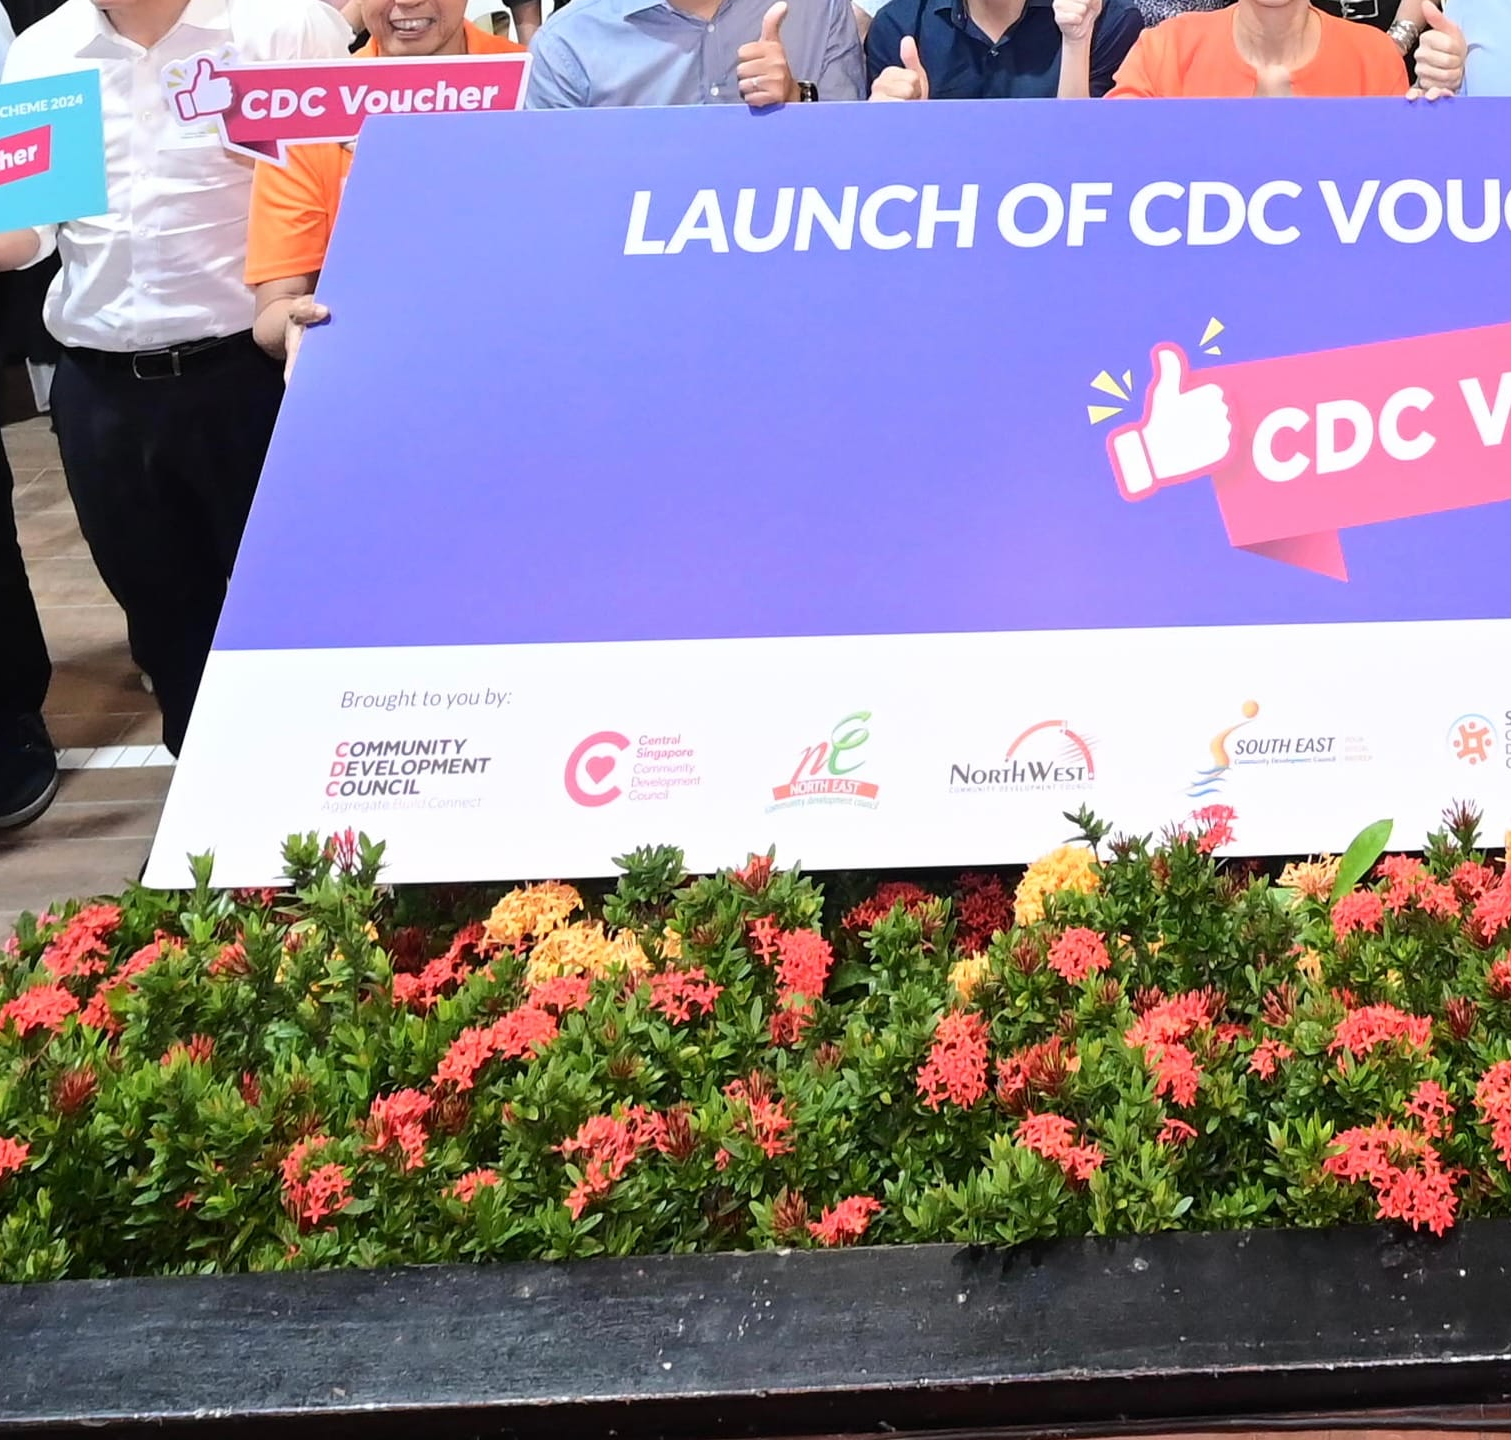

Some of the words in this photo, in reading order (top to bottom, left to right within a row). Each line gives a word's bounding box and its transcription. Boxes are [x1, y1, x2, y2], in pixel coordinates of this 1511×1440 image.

[50, 92, 83, 111] 2024
[241, 88, 327, 120] CDC
[339, 80, 499, 115] Voucher
[621, 183, 981, 258] LAUNCH
[995, 185, 1113, 249] OF
[1126, 179, 1303, 249] CDC
[1250, 384, 1434, 486] CDC
[340, 689, 417, 711] Brought
[422, 690, 441, 708] to
[446, 691, 481, 710] you
[485, 688, 513, 708] by:
[335, 739, 468, 759] COMMUNITY
[638, 734, 682, 746] Central
[1235, 738, 1291, 756] SOUTH
[1295, 737, 1335, 753] EAST
[635, 746, 694, 760] Singapore
[329, 757, 491, 778] DEVELOPMENT
[632, 762, 696, 776] Community
[325, 778, 421, 797] COUNCIL
[630, 775, 701, 788] Development
[790, 781, 828, 795] NORTH
[832, 782, 862, 793] EAST
[628, 788, 669, 802] Council
